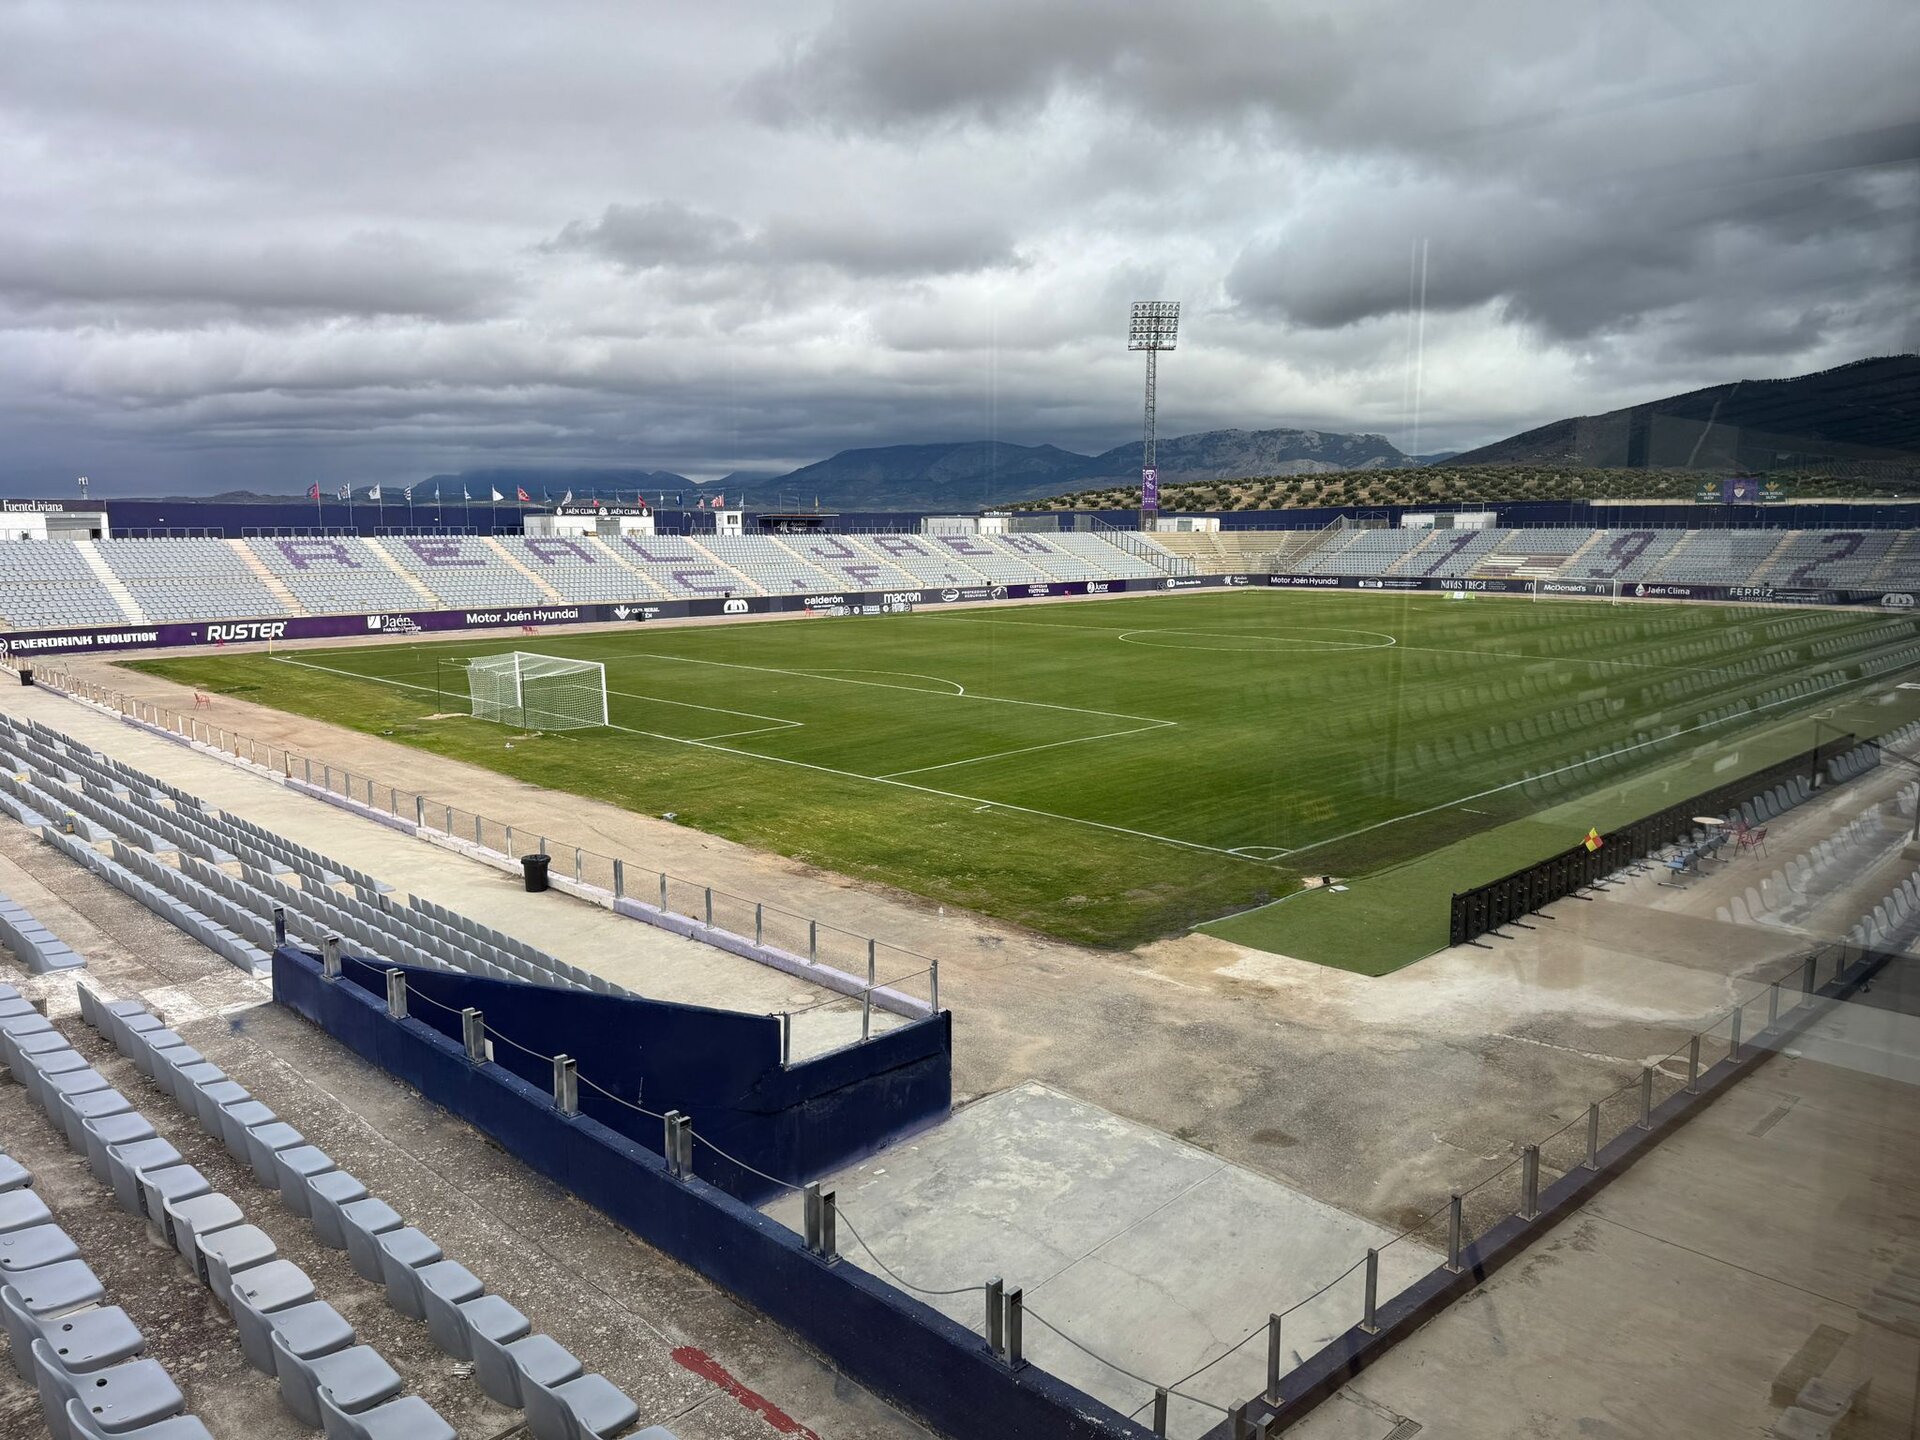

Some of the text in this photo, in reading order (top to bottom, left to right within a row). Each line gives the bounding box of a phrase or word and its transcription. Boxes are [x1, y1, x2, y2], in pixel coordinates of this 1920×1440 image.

[1270, 576, 1339, 586] Motor Jaén Hyundai
[1647, 583, 1691, 595] Jaén Clima
[804, 595, 844, 605] calderón
[884, 592, 921, 603] macron
[466, 608, 579, 624] Motor Jaén Hyundai
[207, 622, 285, 641] RUSTER
[11, 631, 157, 650] ENERDRINK EVOLUTION
